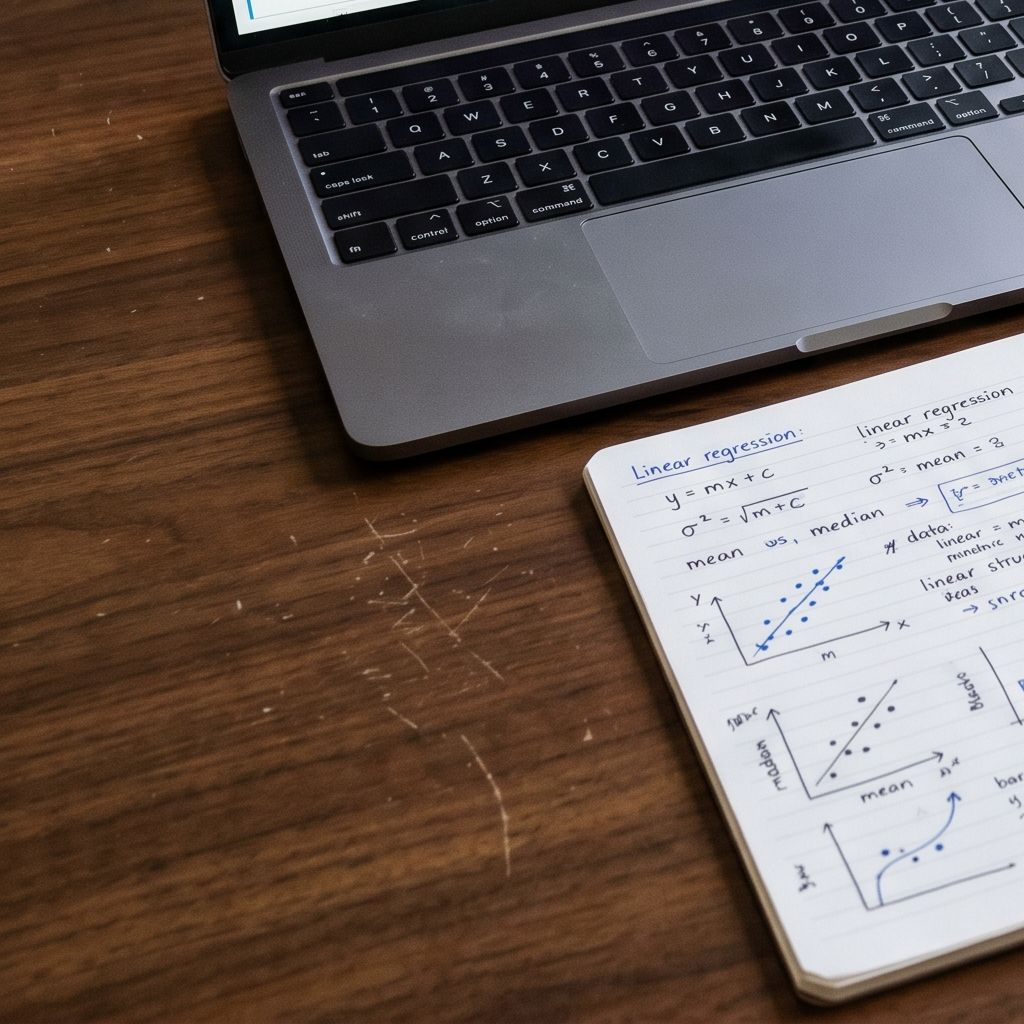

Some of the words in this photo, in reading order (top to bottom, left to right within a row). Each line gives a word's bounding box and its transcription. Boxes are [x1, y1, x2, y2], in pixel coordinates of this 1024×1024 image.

[897, 22, 907, 31] P
[846, 33, 857, 42] O
[741, 54, 753, 63] U
[878, 57, 889, 66] L
[687, 65, 698, 74] Y
[825, 68, 838, 77] K
[539, 71, 549, 79] 4
[632, 77, 643, 86] T
[776, 79, 783, 88] J
[578, 89, 590, 98] R
[718, 91, 731, 100] H
[428, 94, 438, 103] 2
[523, 101, 534, 110] E
[664, 102, 676, 111] G
[817, 101, 832, 110] M
[463, 112, 479, 122] W
[609, 114, 618, 123] F
[763, 113, 777, 122] N
[409, 124, 422, 134] Q
[552, 127, 564, 136] D
[709, 126, 721, 135] B
[496, 138, 507, 148] S
[652, 137, 663, 146] V
[312, 150, 329, 159] tab
[438, 150, 450, 160] A
[598, 149, 609, 159] C
[538, 162, 551, 172] X
[481, 174, 492, 184] Z
[532, 196, 583, 213] command
[475, 214, 509, 227] option
[411, 227, 449, 241] control
[857, 415, 912, 439] linear
[923, 387, 1014, 422] regression
[631, 456, 691, 481] Linear
[704, 428, 803, 464] regression:
[916, 448, 966, 471] mean
[665, 492, 681, 511] y
[907, 523, 953, 543] data:
[686, 547, 744, 570] mean
[809, 507, 885, 537] median
[936, 528, 982, 550] linear
[920, 568, 975, 593] linear
[821, 650, 837, 661] m
[994, 771, 1024, 790] bar
[860, 779, 913, 803] mean
